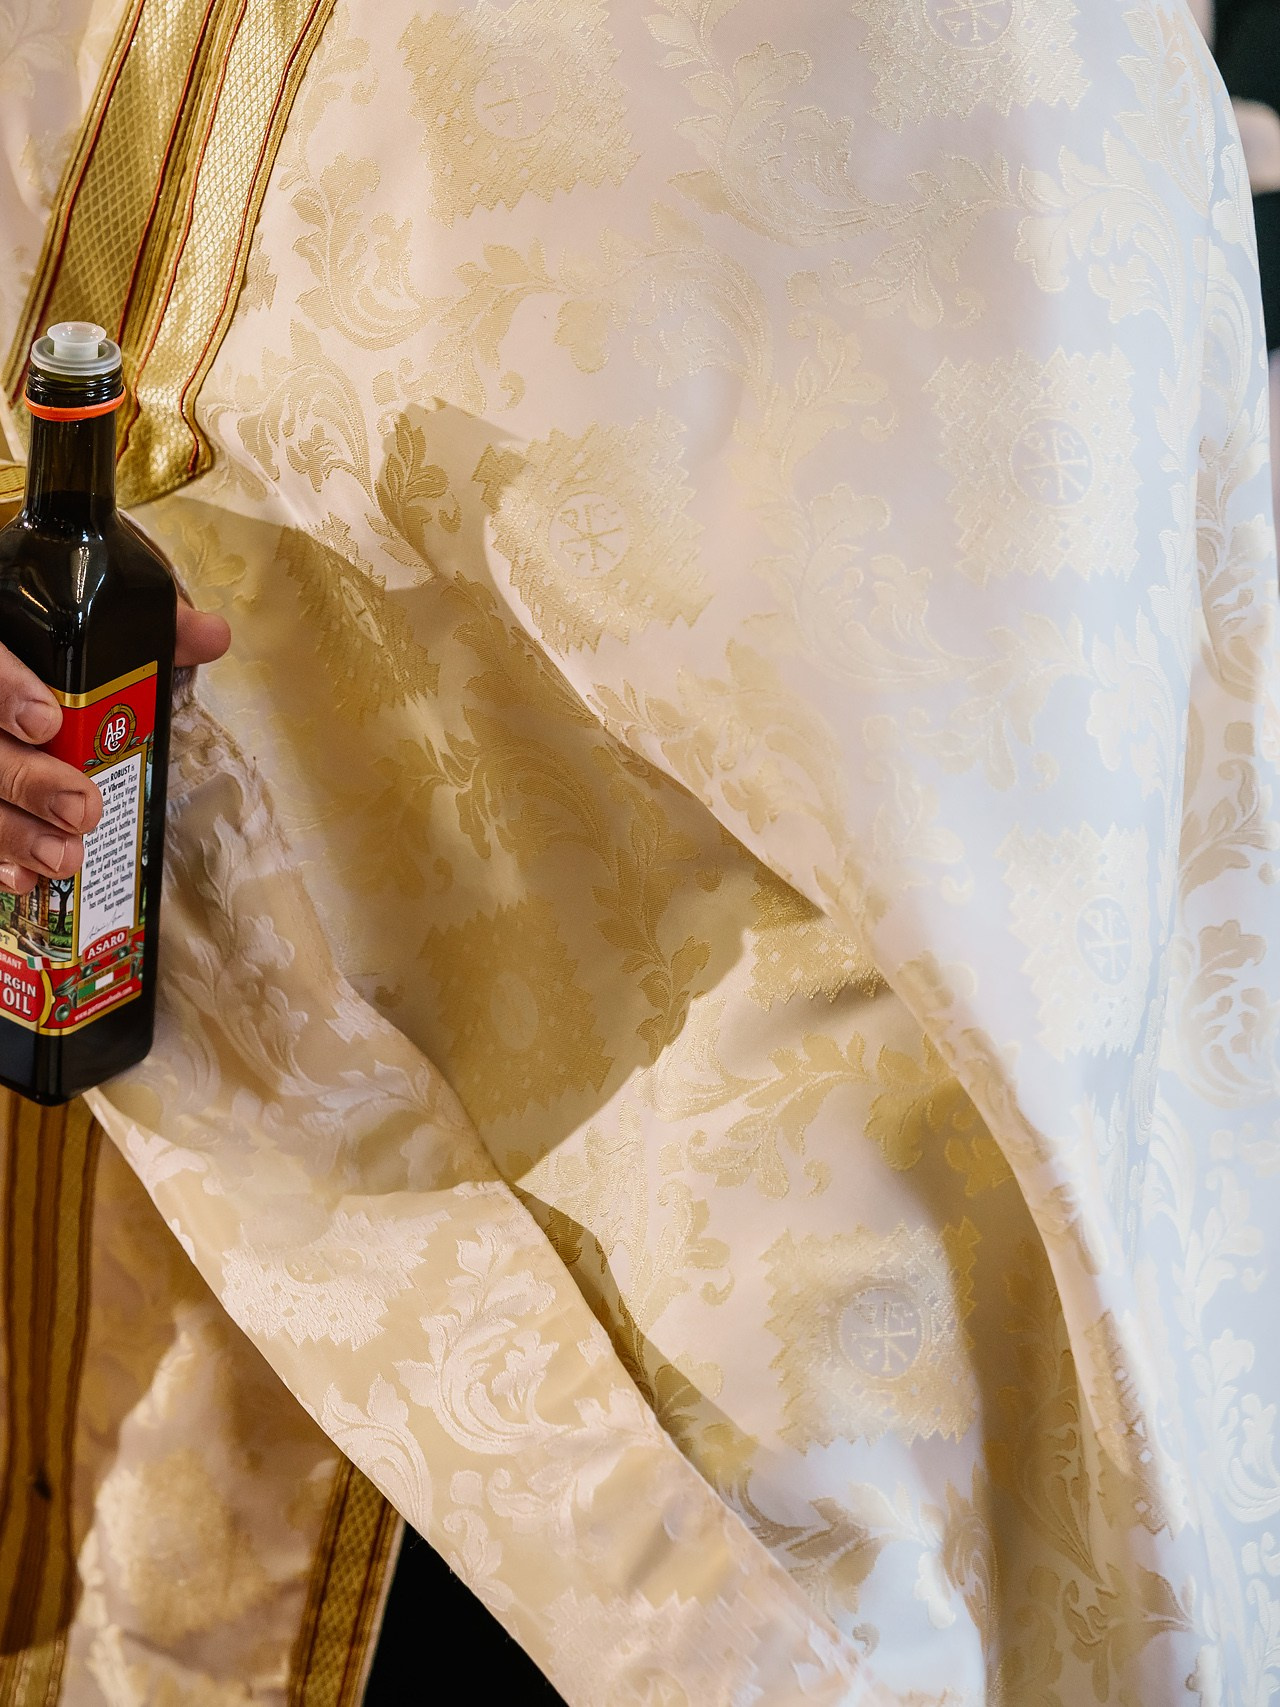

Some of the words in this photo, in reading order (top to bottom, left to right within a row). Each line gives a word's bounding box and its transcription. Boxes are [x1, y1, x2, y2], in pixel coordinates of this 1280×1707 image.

[111, 765, 130, 781] ROBUST
[103, 788, 106, 796] &
[128, 773, 137, 783] First
[113, 792, 124, 801] Extra
[125, 785, 137, 796] Virgin
[110, 803, 121, 814] made
[122, 800, 126, 811] by
[100, 818, 115, 830] squeeze
[116, 811, 120, 821] of
[85, 835, 98, 848] Packed
[109, 823, 117, 835] dark
[119, 818, 130, 830] bottle
[86, 858, 94, 869] With
[103, 848, 117, 860] passing
[119, 842, 123, 851] of
[124, 840, 133, 849] time
[88, 848, 97, 857] keep
[103, 838, 116, 849] fresher
[112, 854, 127, 866] become
[95, 887, 104, 895] same
[120, 870, 133, 882] family
[103, 872, 112, 881] Since
[97, 893, 106, 905] used
[104, 902, 114, 912] Buon
[87, 932, 125, 960] ASARO
[2, 987, 31, 1015] OIL
